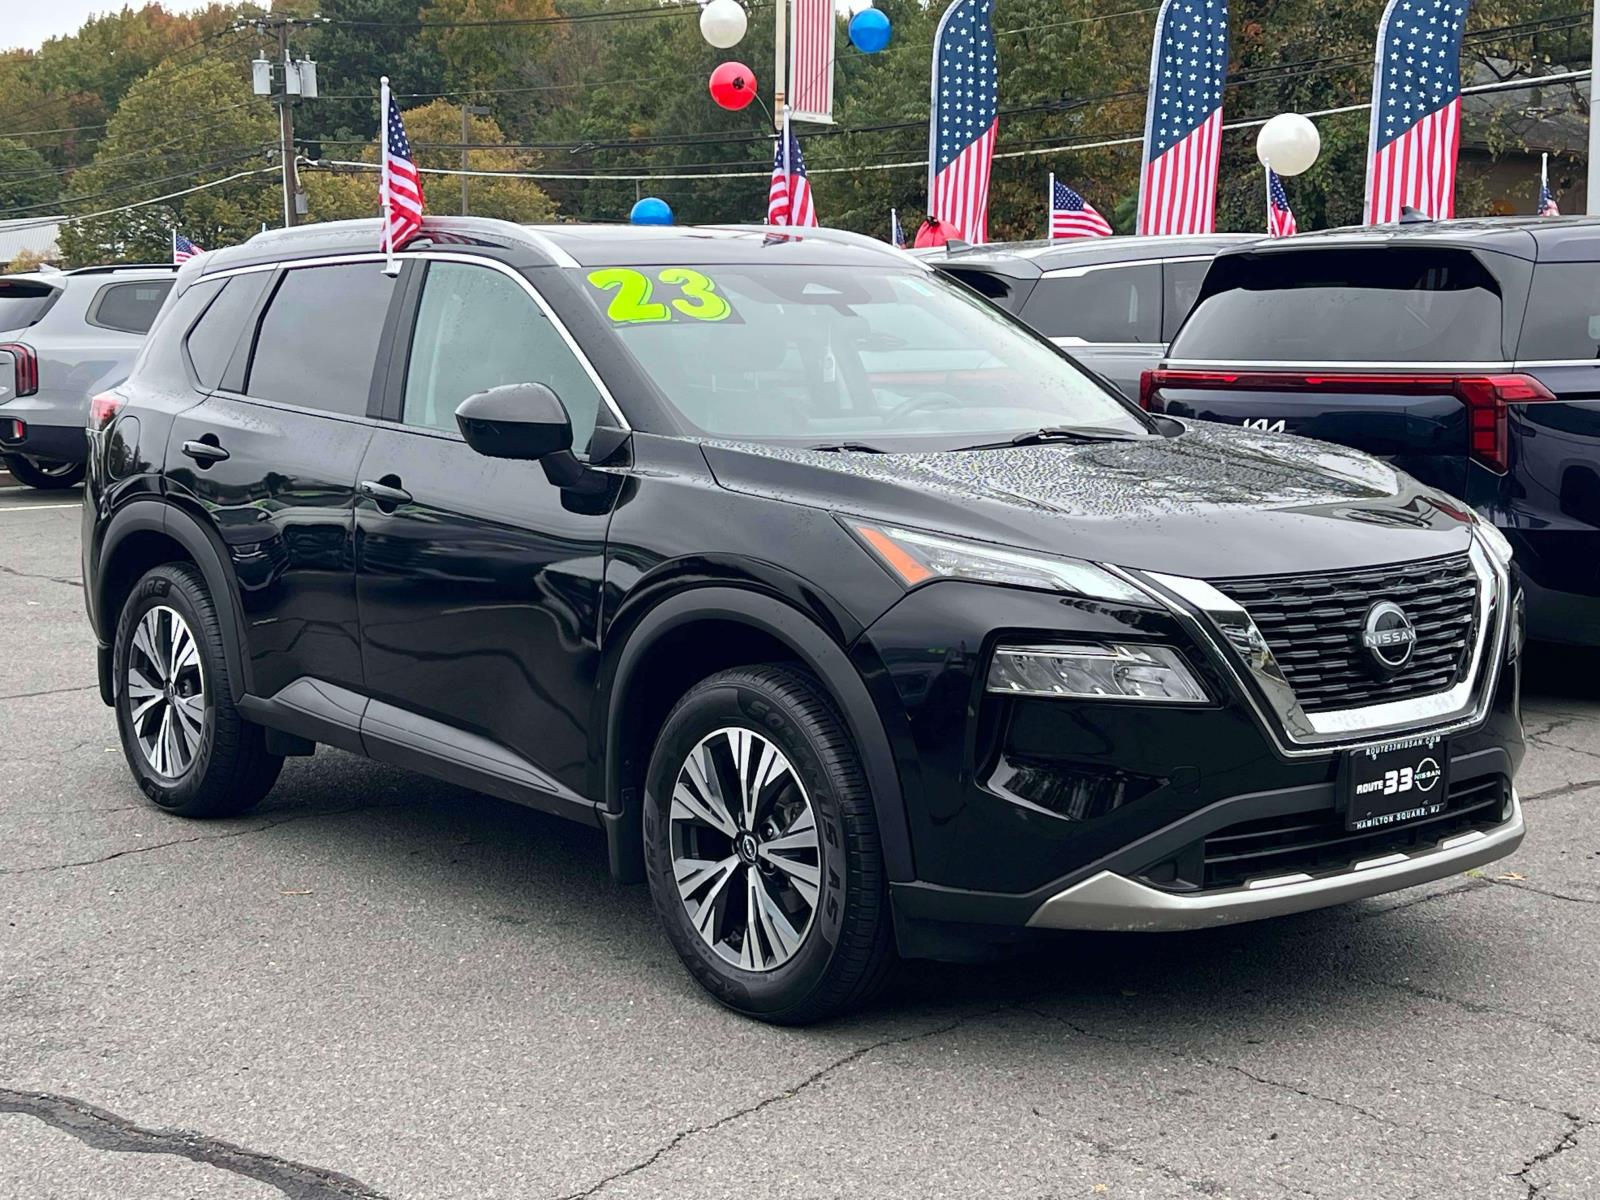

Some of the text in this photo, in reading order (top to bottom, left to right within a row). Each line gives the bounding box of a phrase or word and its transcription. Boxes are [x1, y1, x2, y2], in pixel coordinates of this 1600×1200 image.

[586, 267, 732, 324] 23
[1365, 628, 1417, 646] NISSAN
[1356, 767, 1441, 795] ROUTE 33 NISSAN
[1356, 815, 1394, 830] HAMILTON
